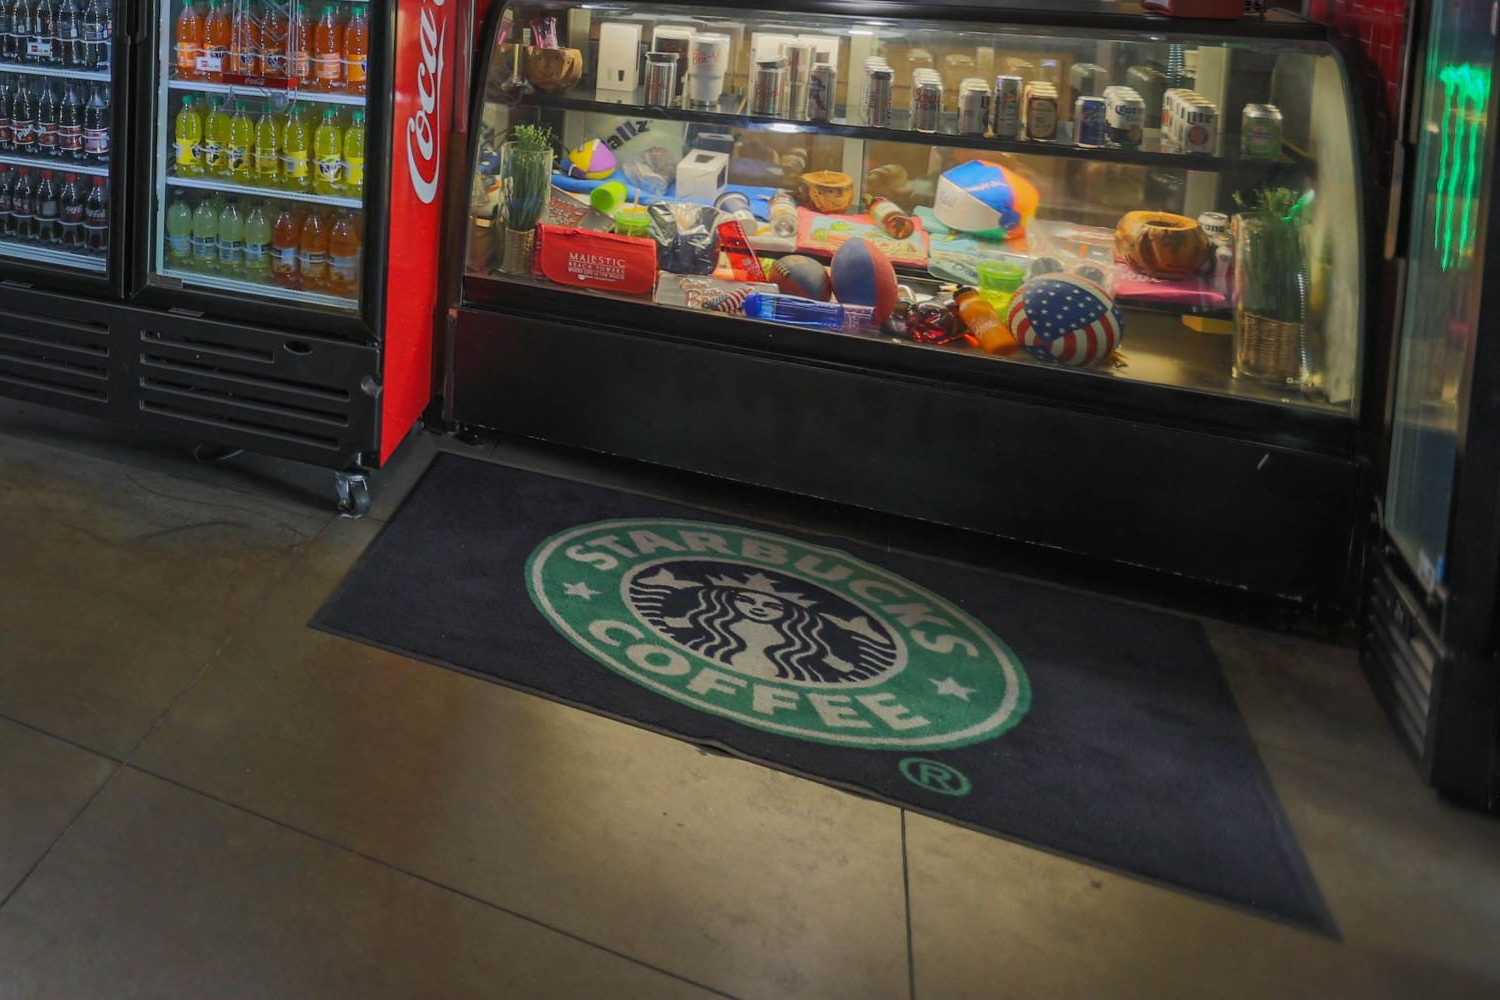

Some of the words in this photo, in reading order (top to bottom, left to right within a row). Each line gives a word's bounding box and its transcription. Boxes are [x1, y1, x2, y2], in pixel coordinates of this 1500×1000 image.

[568, 251, 626, 268] MAJESTIC
[564, 528, 980, 660] STARBUCKS
[586, 618, 933, 732] COFFEE
